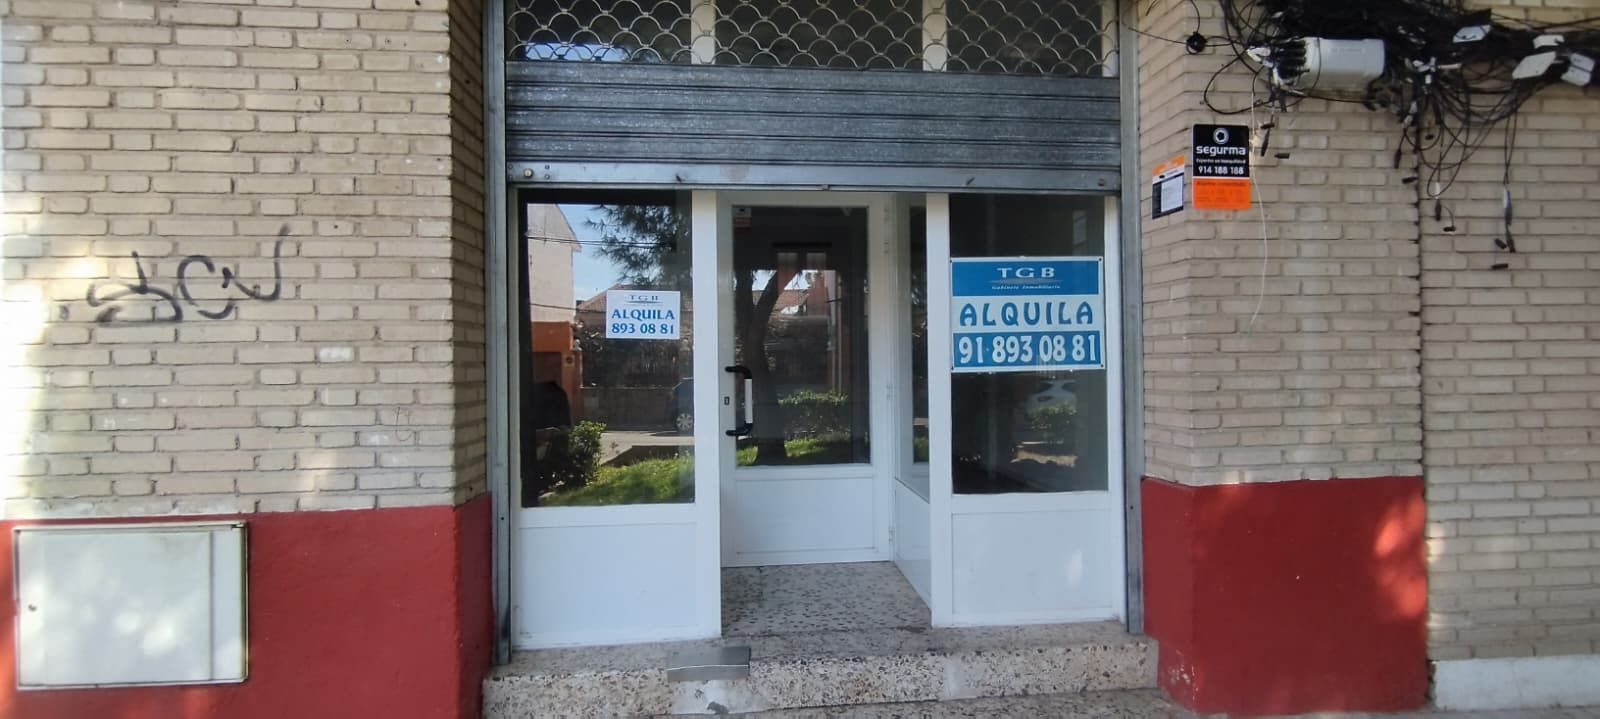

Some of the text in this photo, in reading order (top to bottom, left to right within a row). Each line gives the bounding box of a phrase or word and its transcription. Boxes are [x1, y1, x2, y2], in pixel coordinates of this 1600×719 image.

[1196, 146, 1246, 157] segurma
[1198, 166, 1212, 174] 914
[1214, 166, 1228, 175] 188
[996, 267, 1055, 278] TGB
[611, 308, 675, 321] ALQUILA
[959, 301, 1093, 327] ALQUILA
[611, 323, 674, 334] 893 08 81
[992, 335, 1033, 364] 893
[1039, 334, 1066, 363] 08
[1072, 334, 1096, 362] 81
